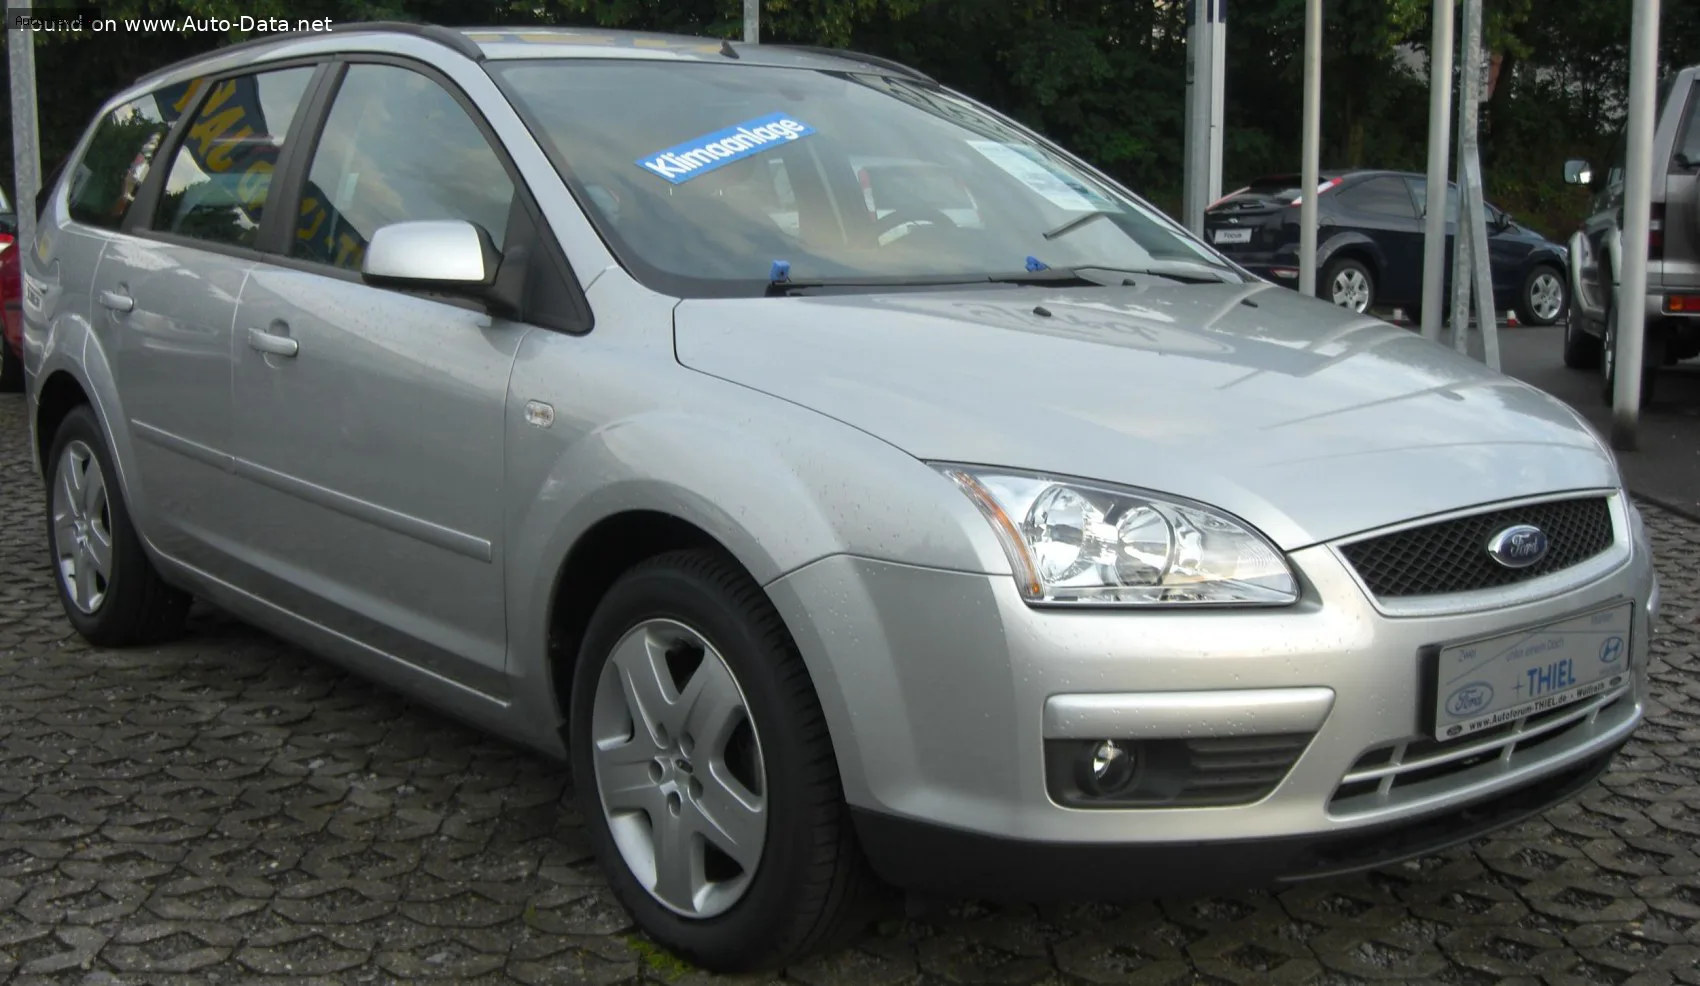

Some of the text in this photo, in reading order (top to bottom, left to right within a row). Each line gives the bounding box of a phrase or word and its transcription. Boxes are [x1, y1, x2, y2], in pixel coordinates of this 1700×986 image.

[645, 118, 804, 179] Klimaanlage
[1527, 658, 1576, 696] THIEL
[1469, 694, 1567, 731] www.Autoforum-THIEL.de
